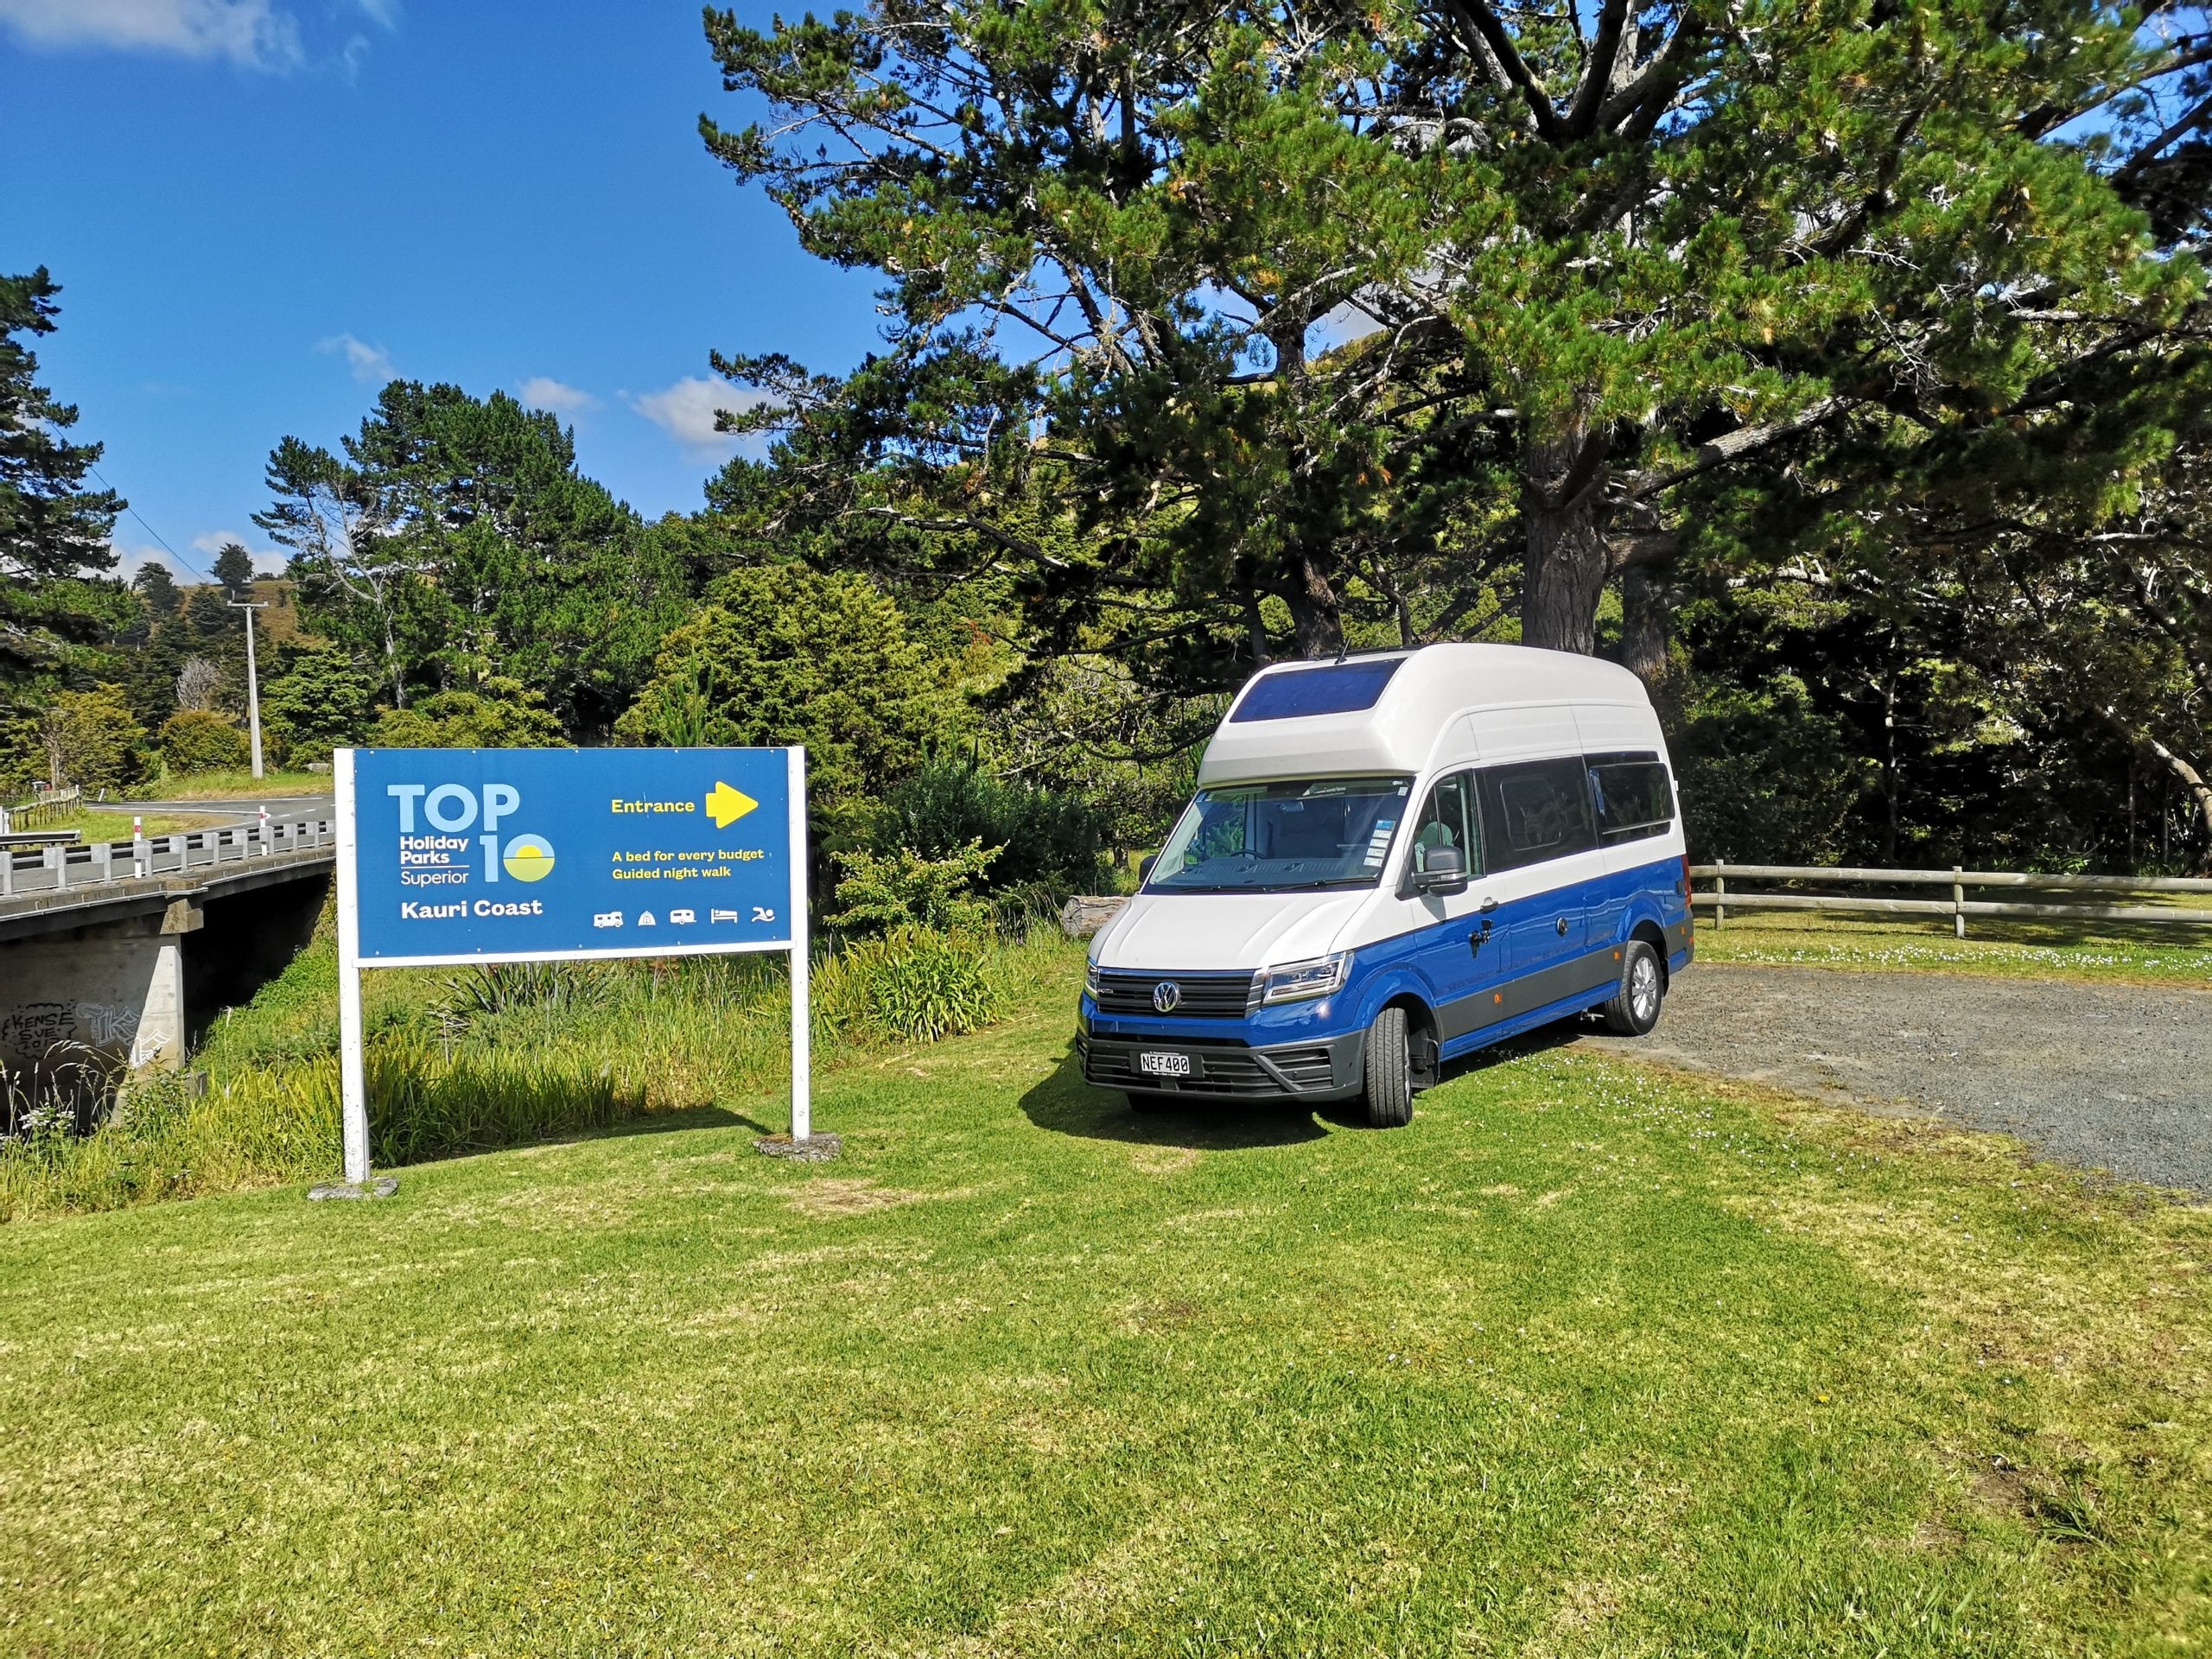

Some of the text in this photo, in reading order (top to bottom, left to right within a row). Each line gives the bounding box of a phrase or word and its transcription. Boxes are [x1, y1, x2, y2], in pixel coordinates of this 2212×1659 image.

[387, 783, 520, 832] TOP
[611, 798, 696, 814] Entrance
[400, 836, 469, 852] Holiday
[400, 850, 450, 865] Parks
[479, 833, 556, 883] 10
[612, 849, 765, 863] A bed for every budget
[400, 869, 469, 887] Superior
[612, 866, 732, 880] Guided night walk
[401, 899, 543, 919] Kauri Coast
[1142, 1055, 1188, 1071] NEF400
